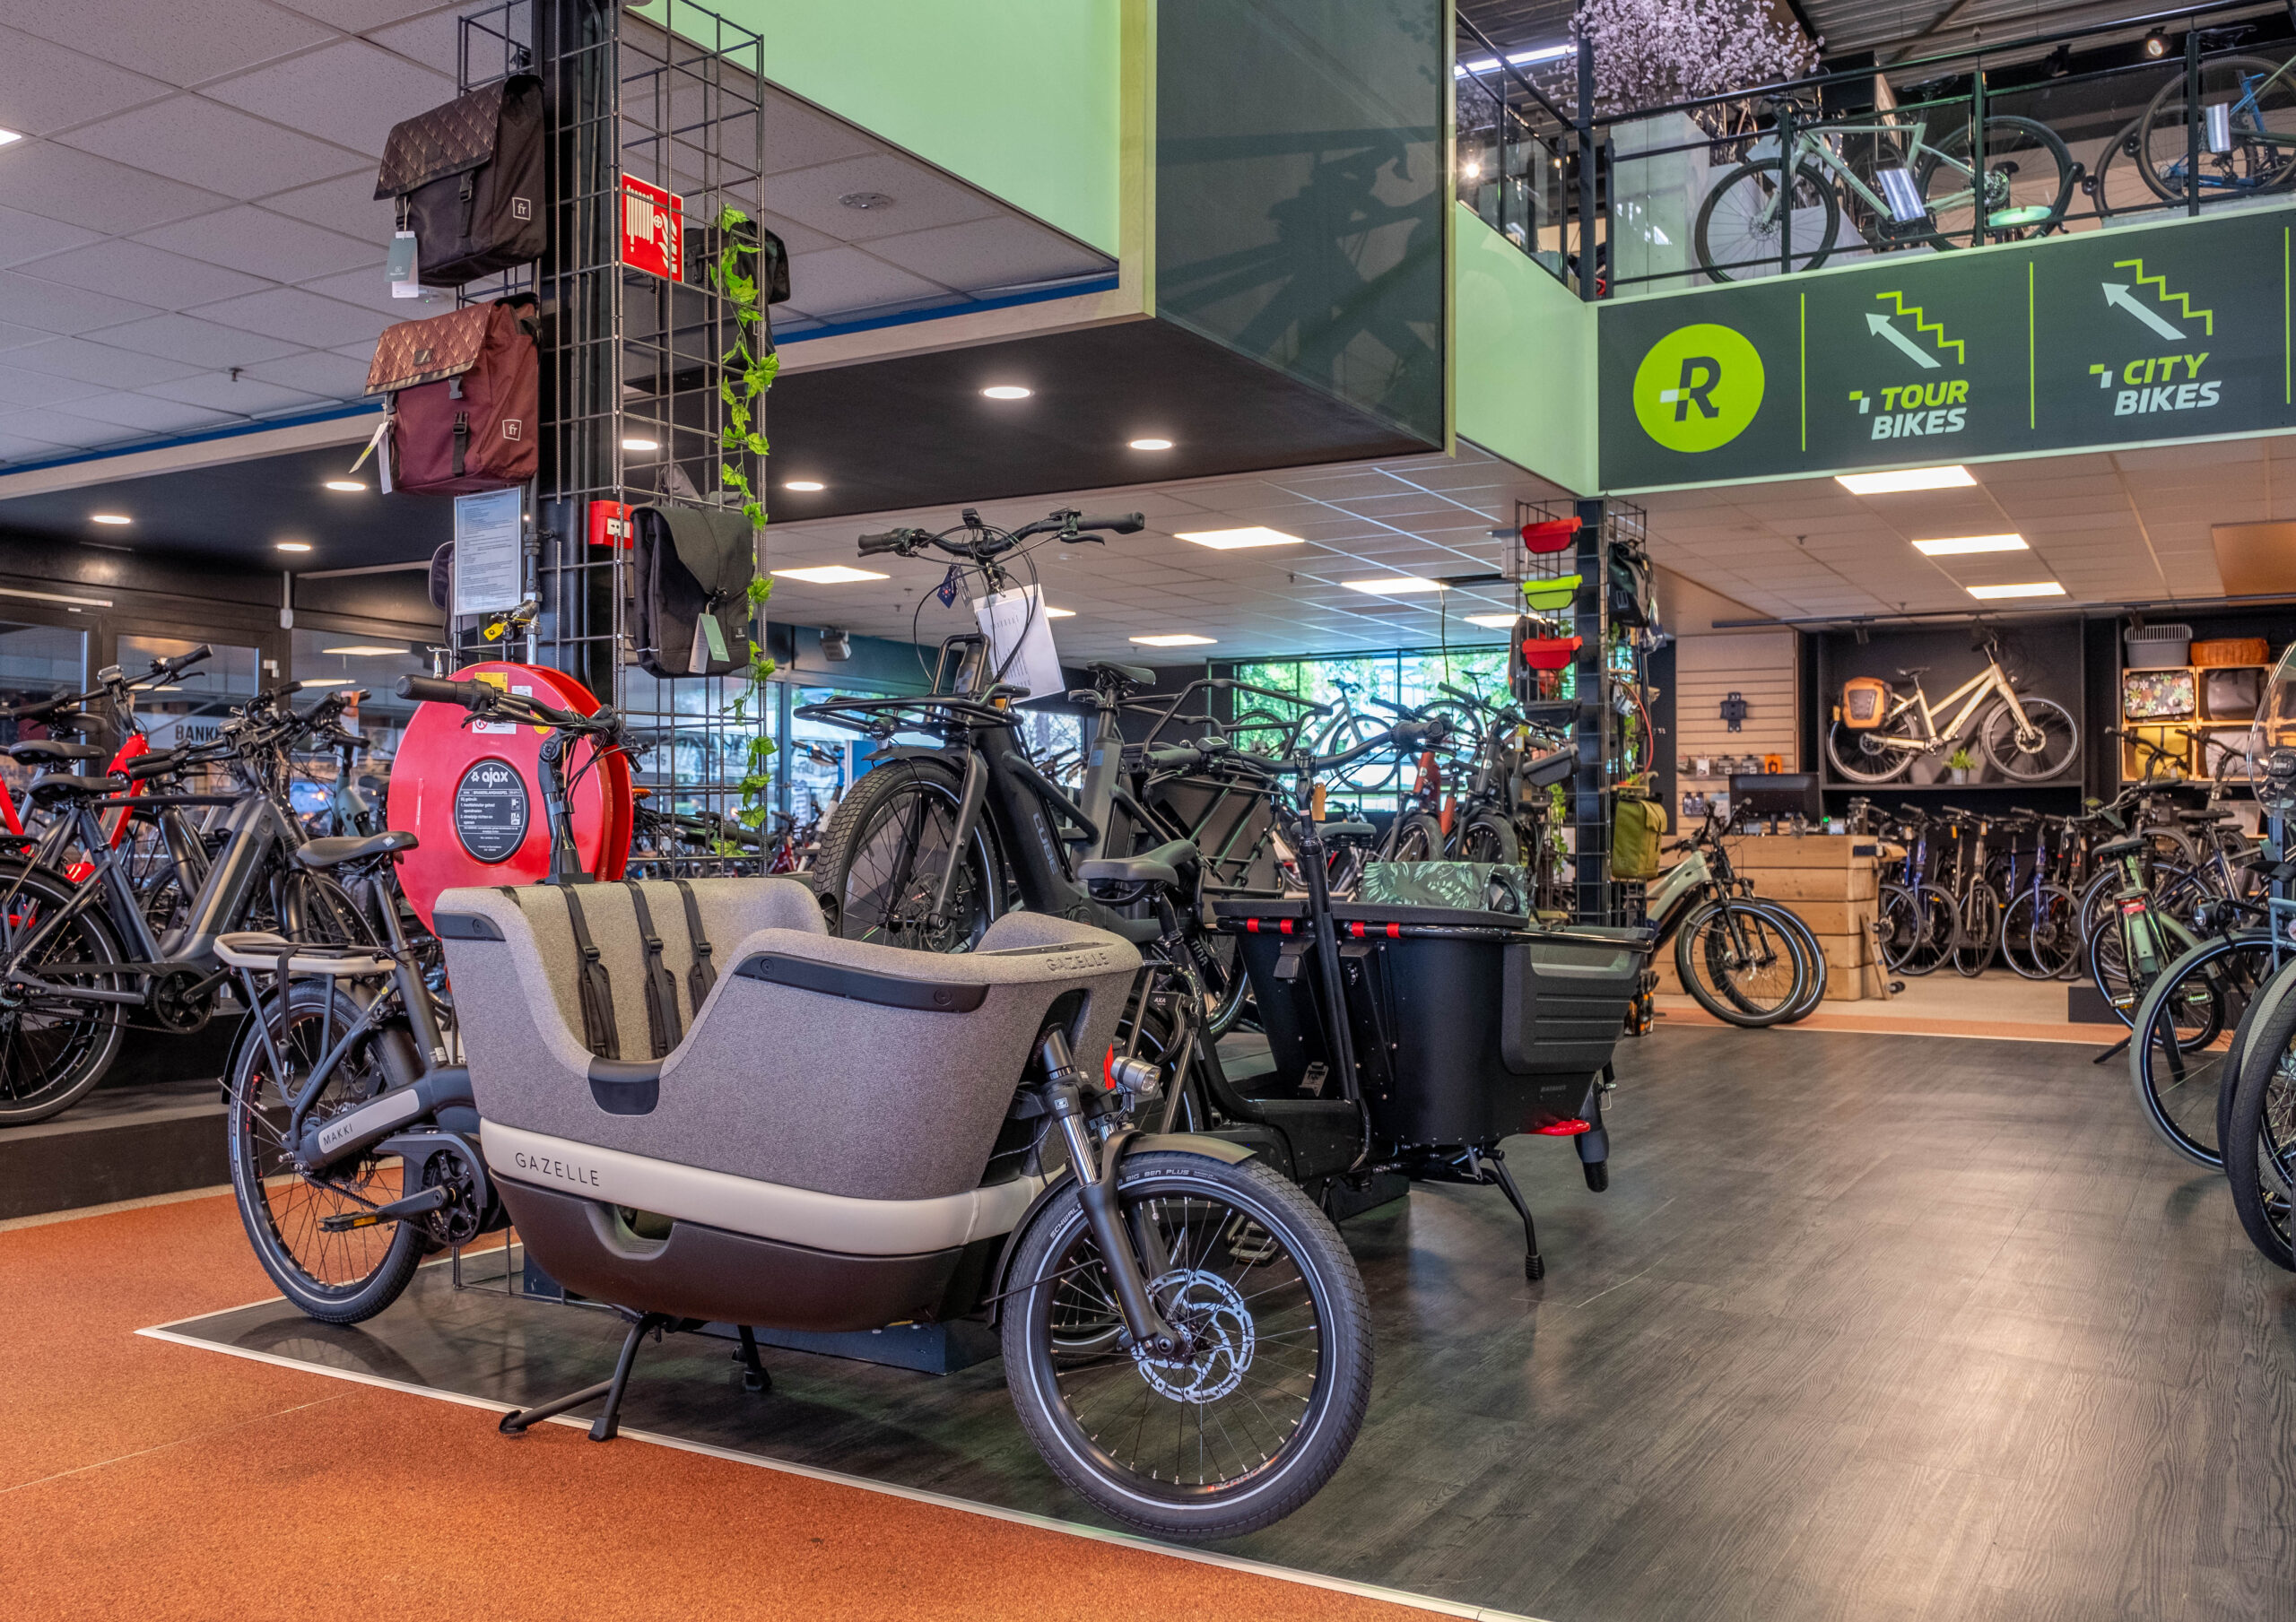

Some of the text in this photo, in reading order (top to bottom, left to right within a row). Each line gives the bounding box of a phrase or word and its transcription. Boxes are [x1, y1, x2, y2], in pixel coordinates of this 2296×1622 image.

[2123, 352, 2211, 386] CITY
[1880, 379, 1970, 412] TOUR
[2113, 380, 2222, 417] BIKES
[1871, 407, 1967, 441] BIKES
[481, 767, 509, 788] ajax
[1033, 812, 1059, 876] CUBE
[1046, 952, 1109, 972] GAZELLE
[323, 1123, 353, 1146] MAKKI
[515, 1152, 600, 1187] GAZELLE
[1126, 1173, 1140, 1183] BIG
[1166, 1168, 1190, 1176] PLUS
